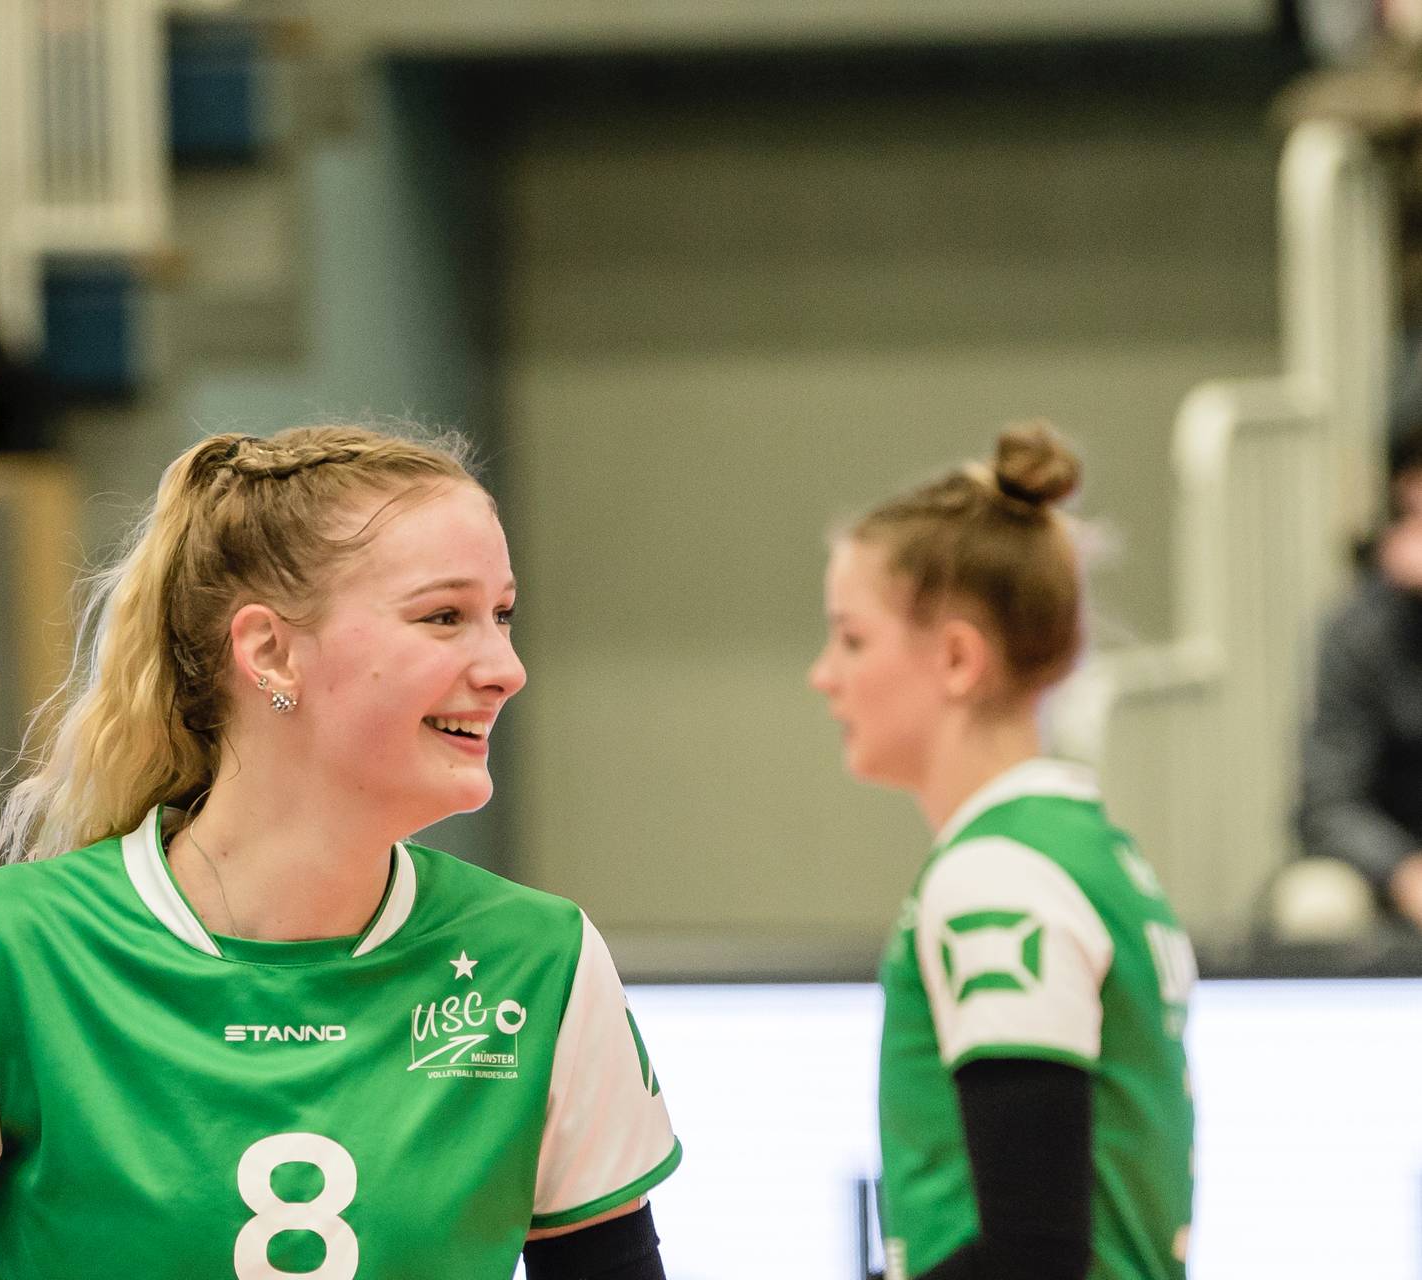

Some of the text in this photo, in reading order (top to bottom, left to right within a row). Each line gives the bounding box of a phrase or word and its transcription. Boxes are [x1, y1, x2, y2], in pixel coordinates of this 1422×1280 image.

[413, 991, 488, 1041] USC
[224, 1025, 347, 1042] STANNO
[471, 1050, 515, 1065] MÜNSTER
[427, 1069, 519, 1080] VOLLEYBALL BUNDESLIGA
[234, 1132, 359, 1280] 8
